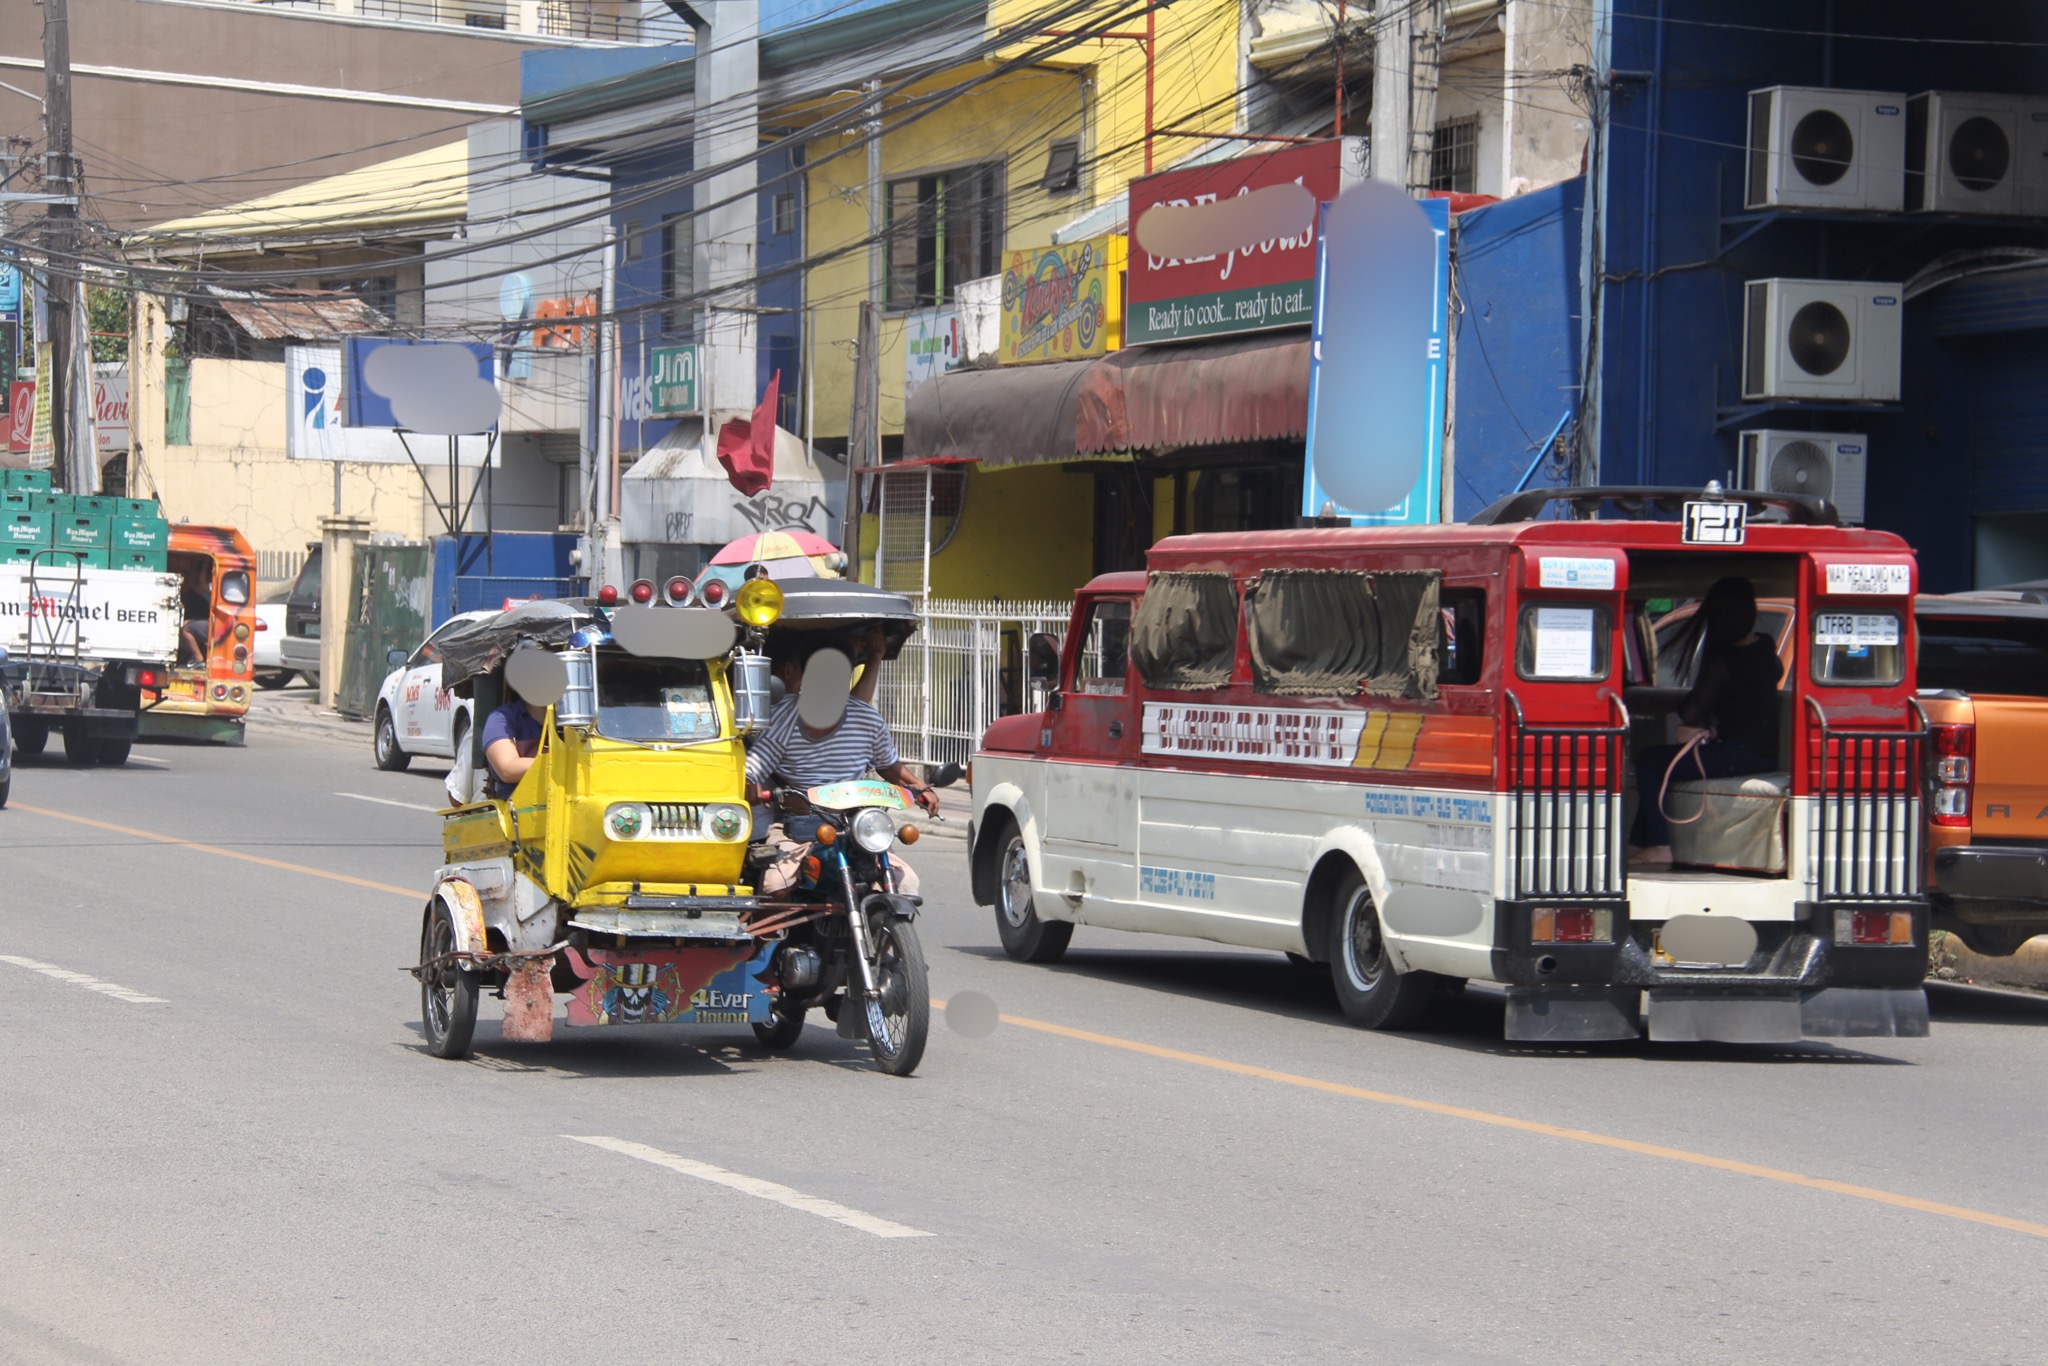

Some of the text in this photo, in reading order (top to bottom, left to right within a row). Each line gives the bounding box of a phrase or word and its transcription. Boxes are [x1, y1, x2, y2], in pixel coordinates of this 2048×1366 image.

[1148, 288, 1312, 335] Ready to cook... ready to eat...
[1828, 566, 1845, 583] MAY
[1848, 566, 1888, 583] REKLAMO
[117, 610, 157, 623] BEER
[1818, 616, 1853, 634] LTFRB
